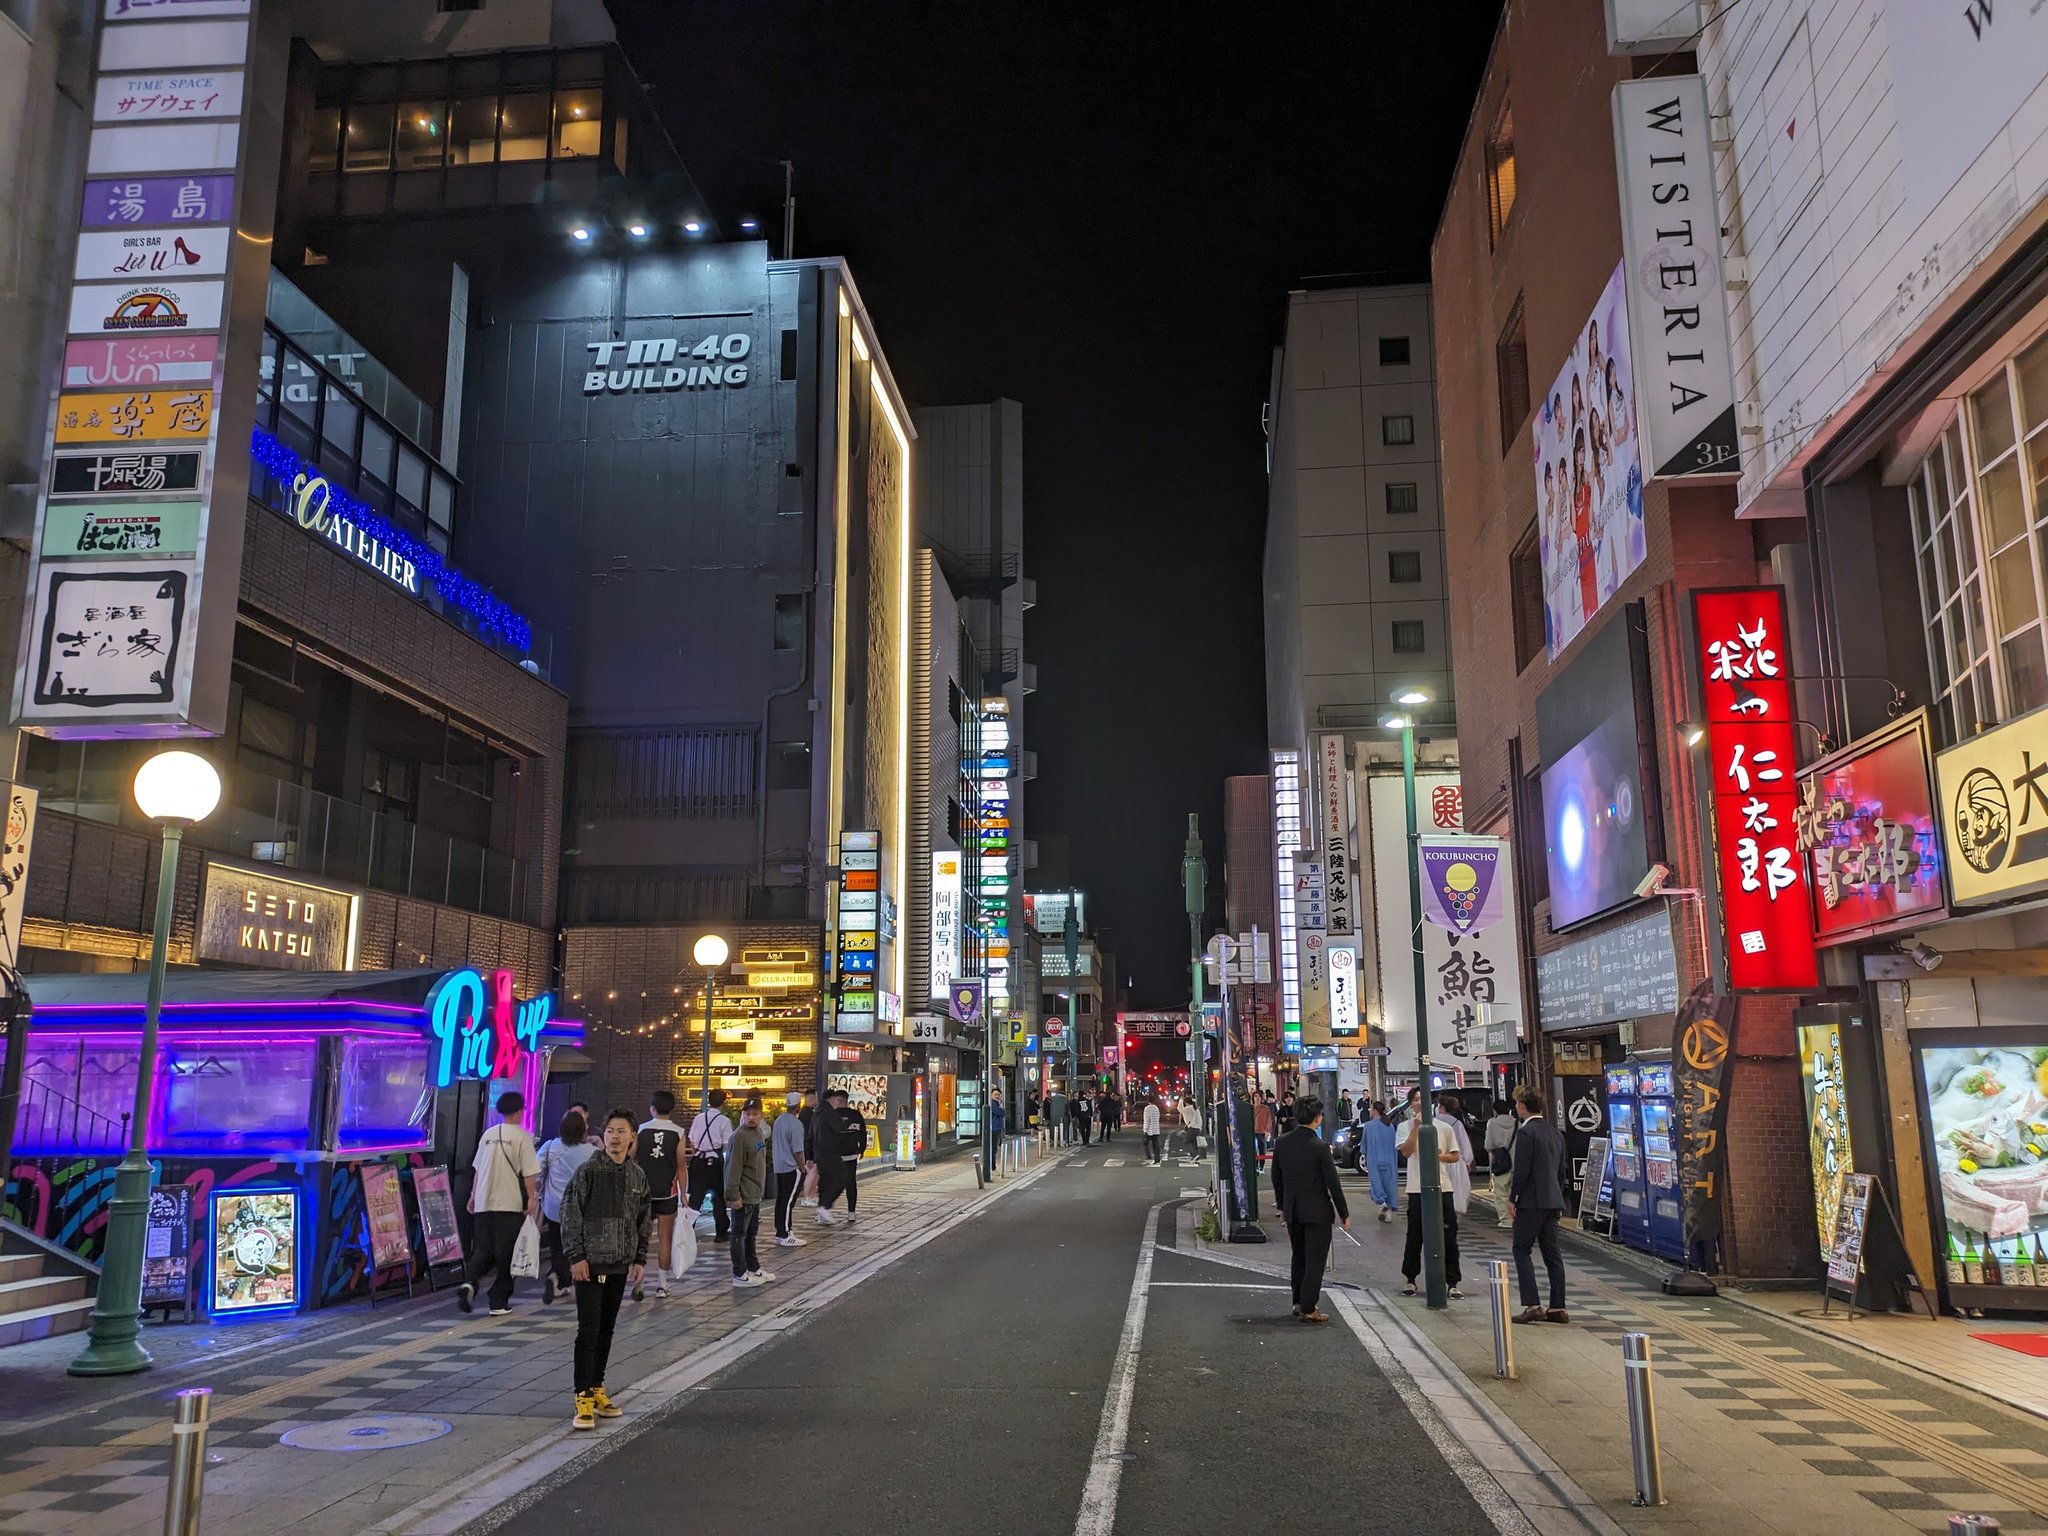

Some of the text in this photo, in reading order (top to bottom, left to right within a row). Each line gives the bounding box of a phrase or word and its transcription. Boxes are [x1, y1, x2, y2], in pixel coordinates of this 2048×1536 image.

[127, 78, 214, 91] TIME SPACE
[117, 93, 219, 114] サブウェイ
[123, 238, 161, 247] GIRL'S BAR
[1645, 96, 1708, 415] WISTERIA
[116, 286, 181, 305] DRINK and FOOD
[103, 314, 188, 330] SEVEN COLOR BRIDGE
[587, 333, 751, 367] TM-40
[583, 364, 749, 394] BUILDING
[1696, 442, 1730, 464] 3F
[327, 513, 416, 593] ATELIER
[1425, 852, 1496, 862] KOKUBUNCHO
[244, 890, 315, 924] SETO
[241, 926, 312, 957] KATSU
[935, 891, 952, 987] 阿部写真館
[432, 970, 549, 1087] Pin up
[1010, 1021, 1022, 1041] P
[679, 1066, 736, 1075] アナロガーデン
[1683, 1080, 1693, 1141] NIGHT
[650, 1131, 665, 1159] 日本
[1694, 1081, 1721, 1198] ART
